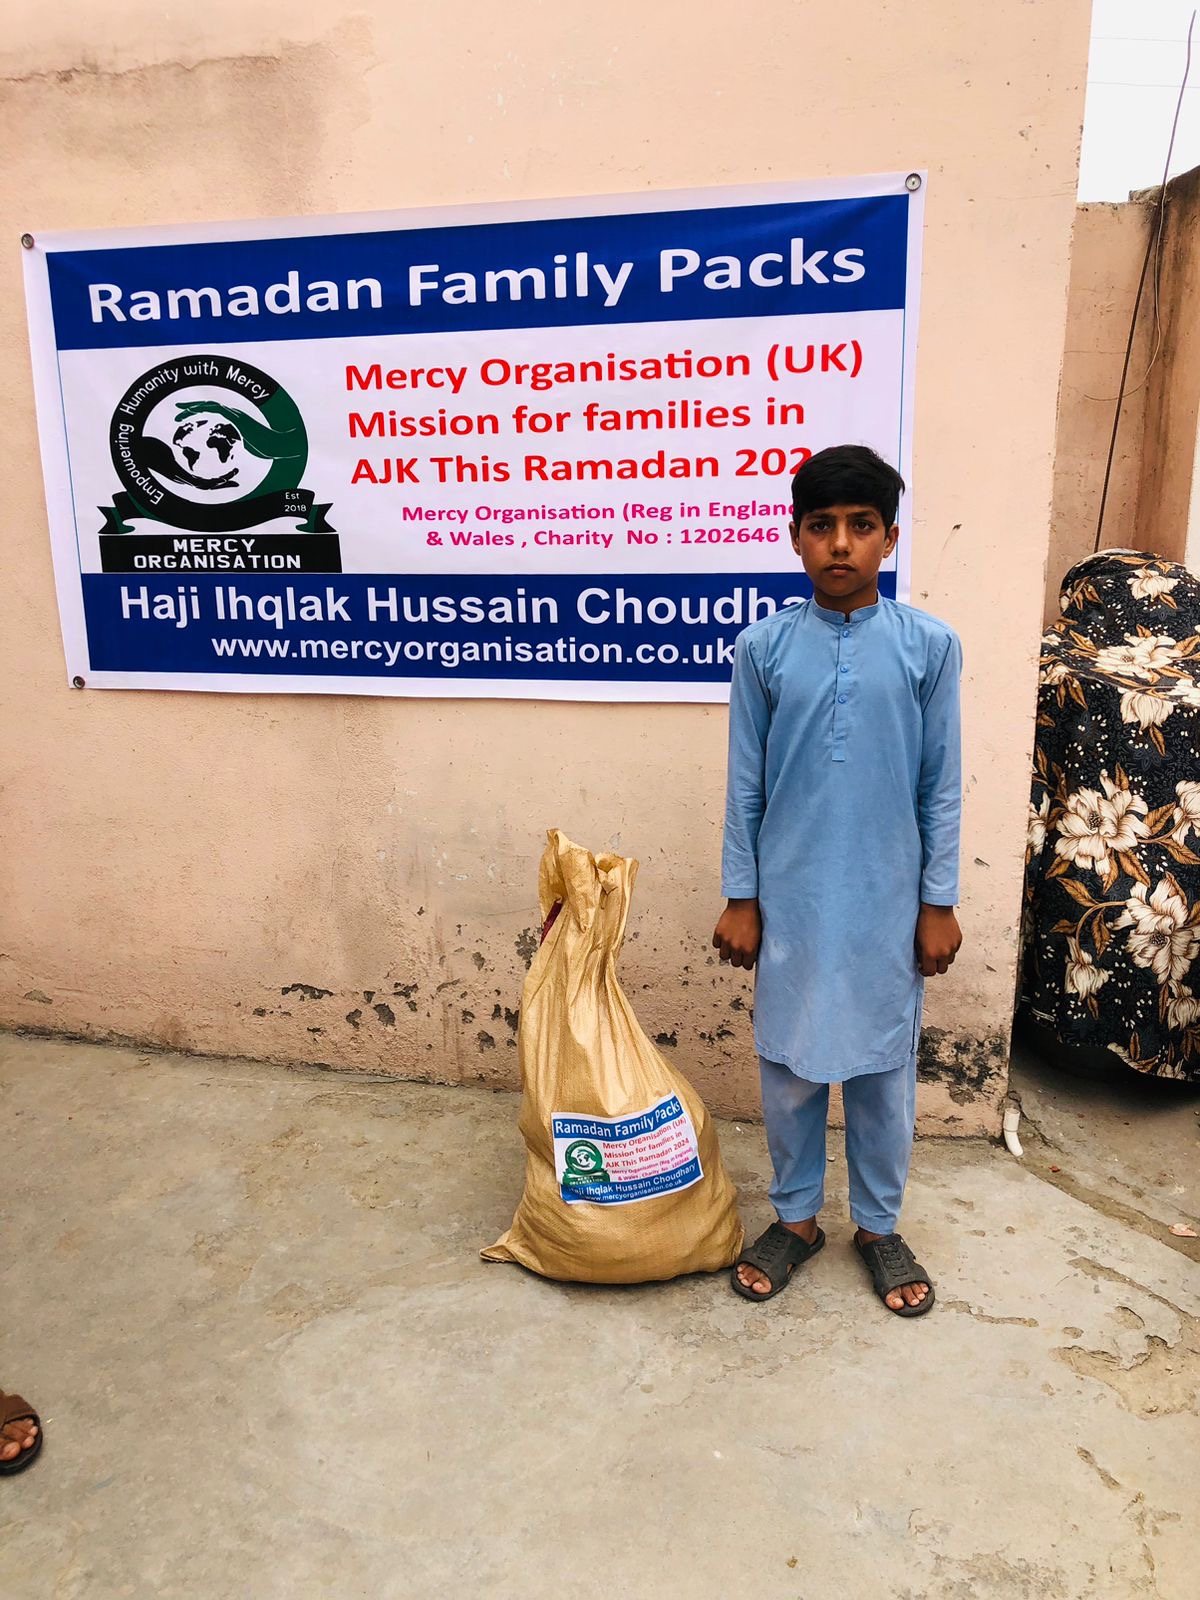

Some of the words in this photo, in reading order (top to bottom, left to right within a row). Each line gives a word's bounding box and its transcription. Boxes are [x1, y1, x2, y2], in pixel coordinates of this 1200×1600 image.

[88, 270, 383, 323] Ramadan
[409, 252, 634, 307] Family
[660, 237, 866, 293] Packs
[184, 361, 219, 377] with
[345, 363, 467, 394] Mercy
[480, 349, 750, 391] Organisation
[767, 340, 863, 381] (UK)
[120, 366, 179, 416] Humanity
[226, 365, 270, 400] Mercy
[349, 409, 499, 438] Mission
[512, 405, 571, 434] for
[583, 399, 751, 432] families
[767, 397, 805, 425] in
[115, 422, 165, 505] Empowering
[351, 457, 420, 485] AJK
[430, 455, 511, 483] This
[524, 450, 719, 481] Ramadan
[735, 447, 812, 476] 202
[284, 504, 307, 513] 2018
[285, 492, 300, 500] Est
[402, 506, 469, 524] Mercy
[475, 504, 615, 523] Organisation
[622, 502, 673, 522] (Reg
[680, 502, 700, 518] in
[708, 500, 795, 521] Englan
[173, 538, 256, 553] MERCY
[426, 531, 443, 546] &
[450, 530, 515, 547] Wales
[534, 530, 613, 548] Charity
[626, 530, 659, 545] No
[680, 527, 780, 545] 1202646
[134, 554, 301, 569] ORGANISATION
[120, 586, 201, 629] Haji
[215, 586, 352, 630] Ihqlak
[367, 587, 559, 623] Hussain
[576, 587, 807, 625] Choudh
[211, 637, 735, 668] www.mercyorganisation.co.uk
[555, 1121, 612, 1137] Ramadan
[615, 1116, 654, 1137] Family
[655, 1100, 681, 1123] Packs
[602, 1142, 627, 1151] Mercy
[628, 1125, 672, 1147] Organisation
[604, 1149, 634, 1159] Mission
[635, 1145, 647, 1155] for
[648, 1134, 675, 1150] families
[605, 1161, 620, 1169] AJK
[621, 1158, 637, 1168] This
[639, 1146, 673, 1163] Ramadan
[615, 1180, 651, 1192] Hussain
[653, 1162, 697, 1185] Choudhary
